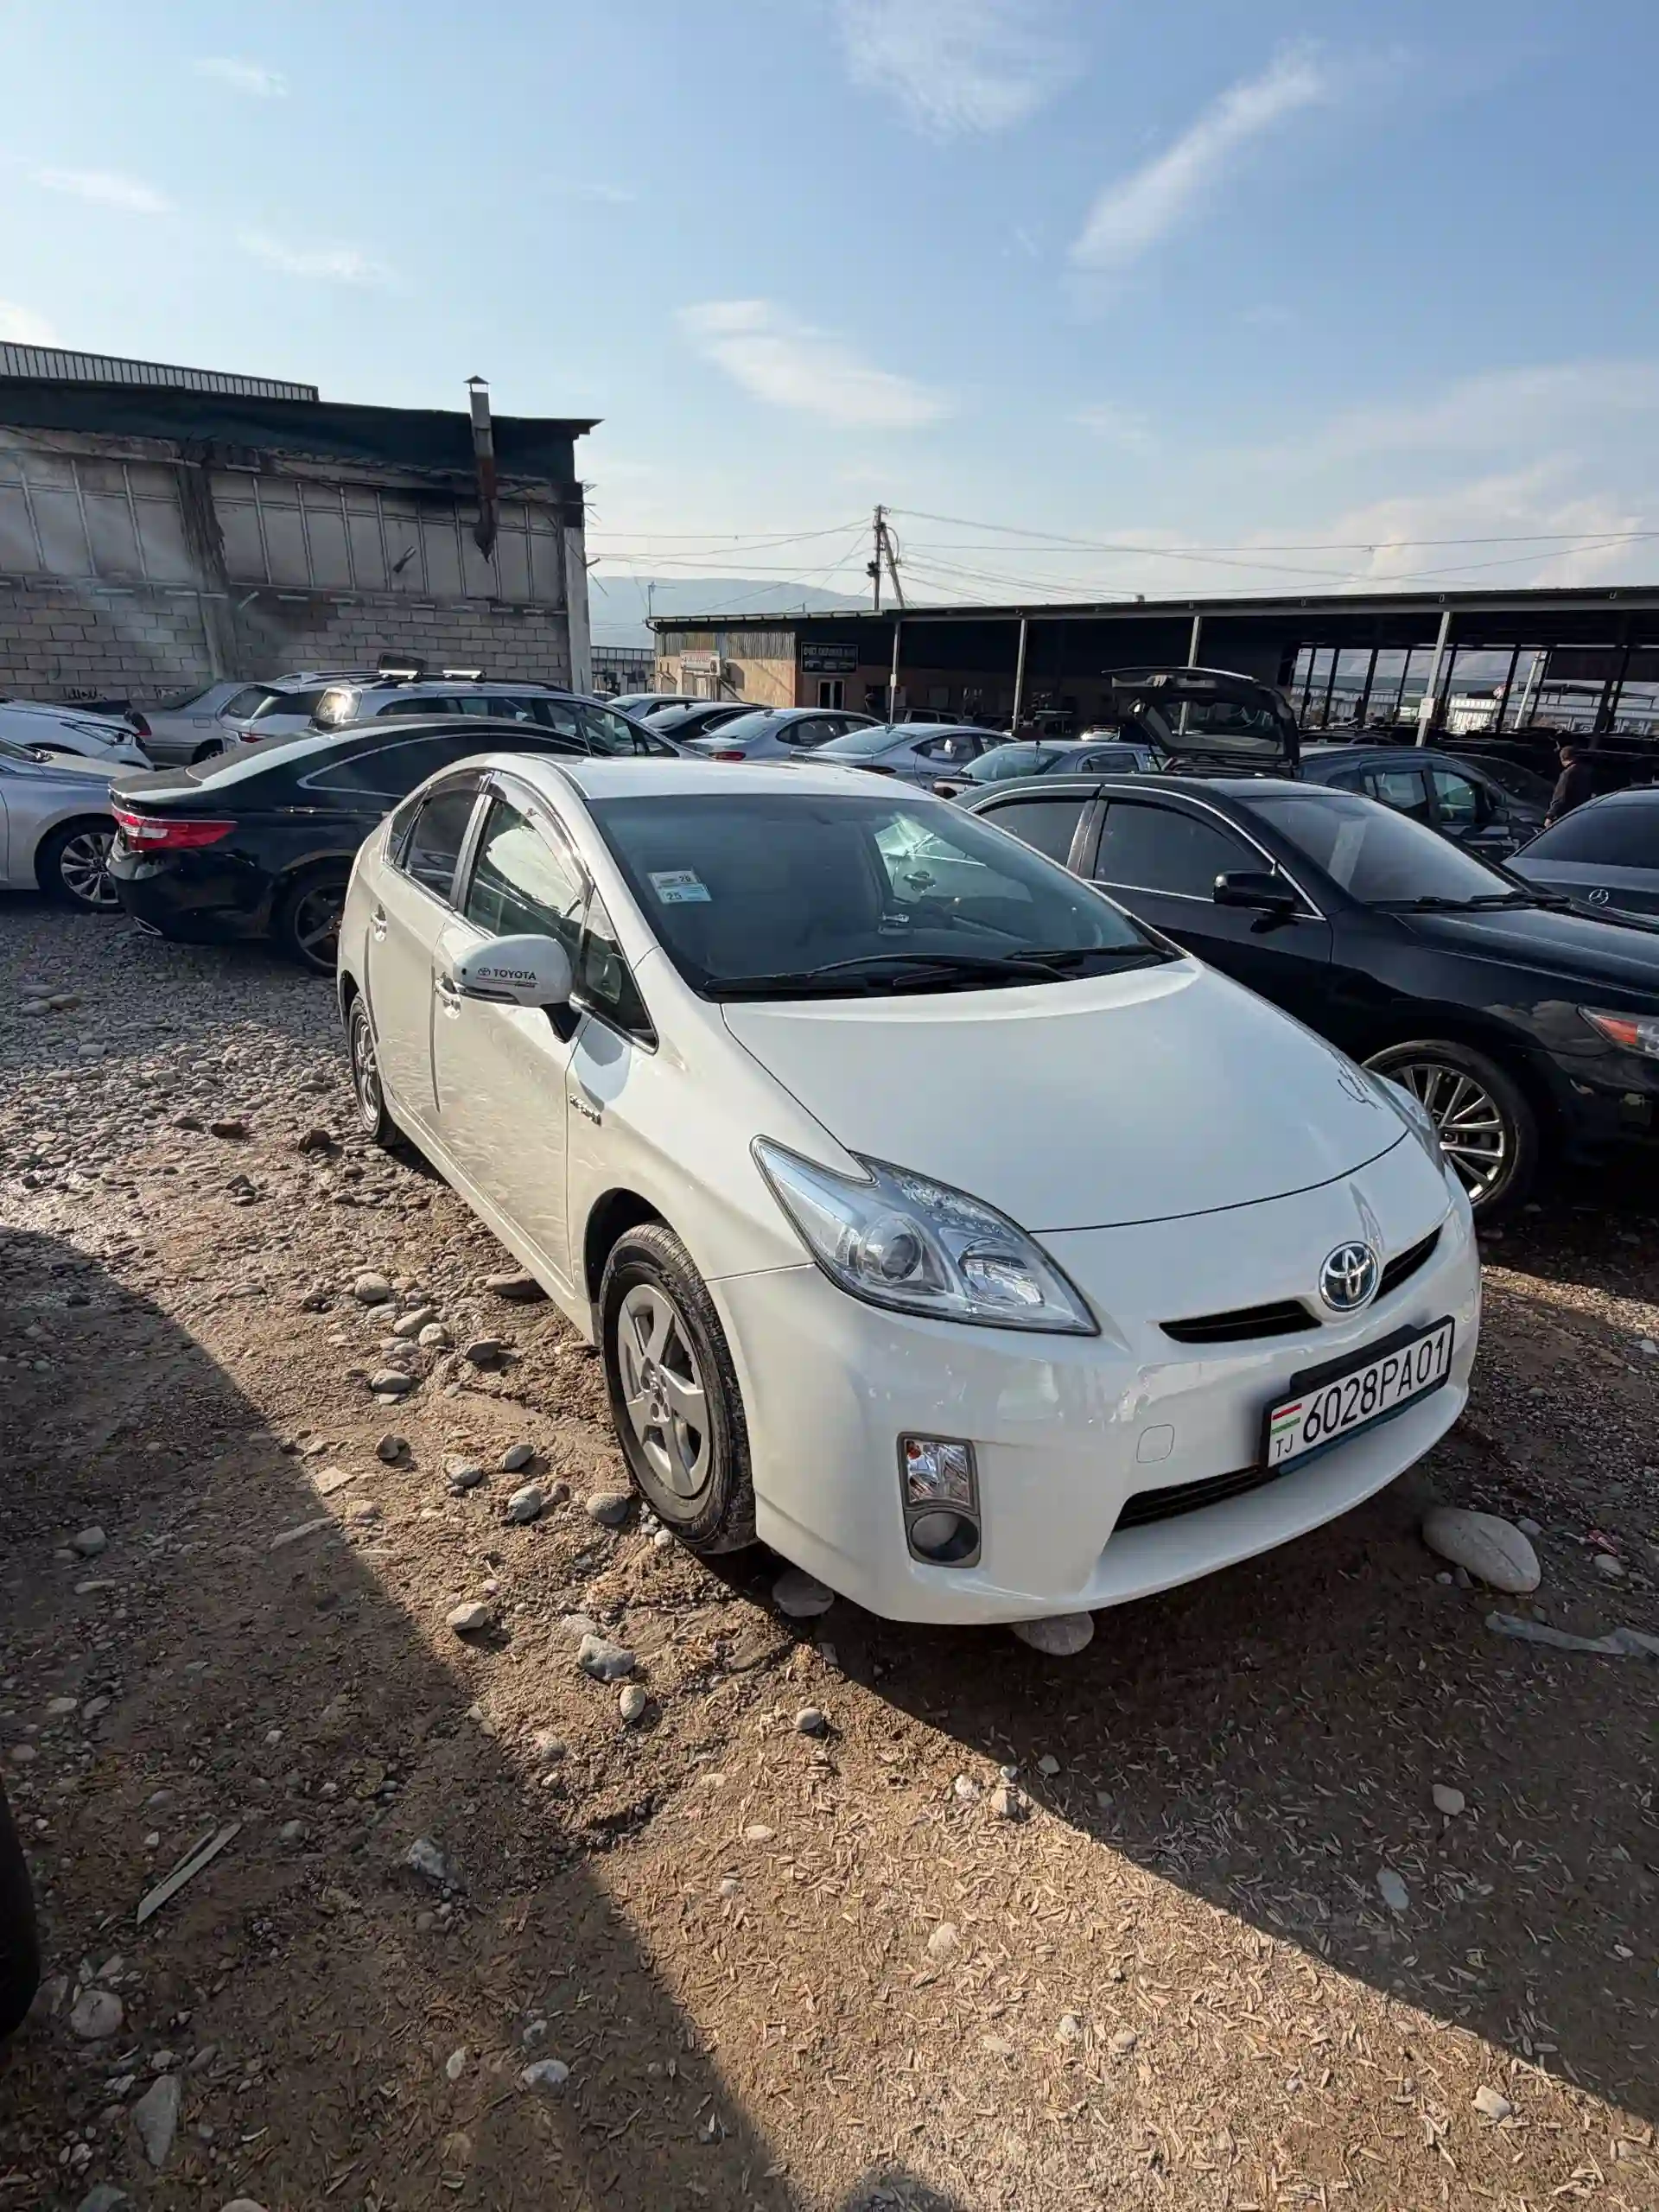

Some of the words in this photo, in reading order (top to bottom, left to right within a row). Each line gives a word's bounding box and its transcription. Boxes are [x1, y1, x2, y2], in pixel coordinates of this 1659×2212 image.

[493, 969, 537, 981] TOYOTA
[1302, 1331, 1445, 1443] 6028PA01
[1275, 1433, 1294, 1458] TJ
